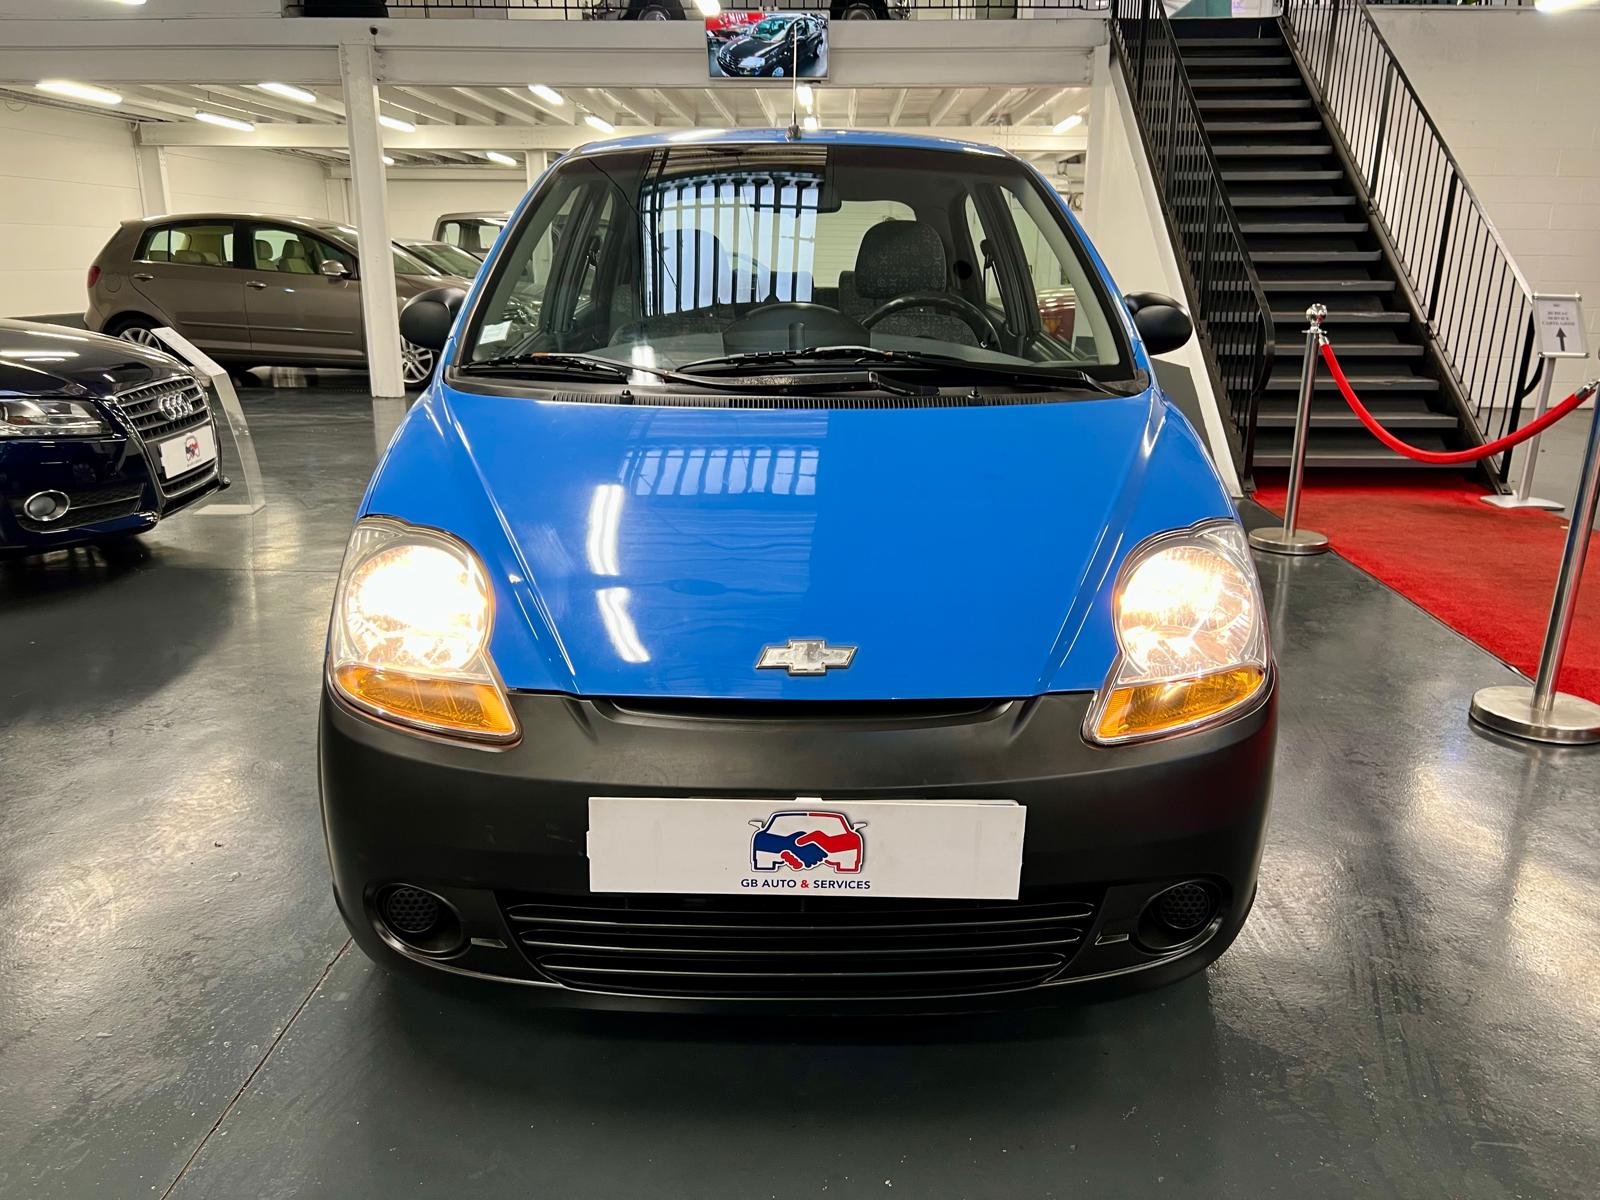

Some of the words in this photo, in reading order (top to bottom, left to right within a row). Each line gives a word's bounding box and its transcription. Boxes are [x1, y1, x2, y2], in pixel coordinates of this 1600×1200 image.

[741, 878, 758, 888] GB
[761, 879, 797, 888] AUTO
[800, 879, 810, 889] &
[813, 880, 871, 889] SERVICES
